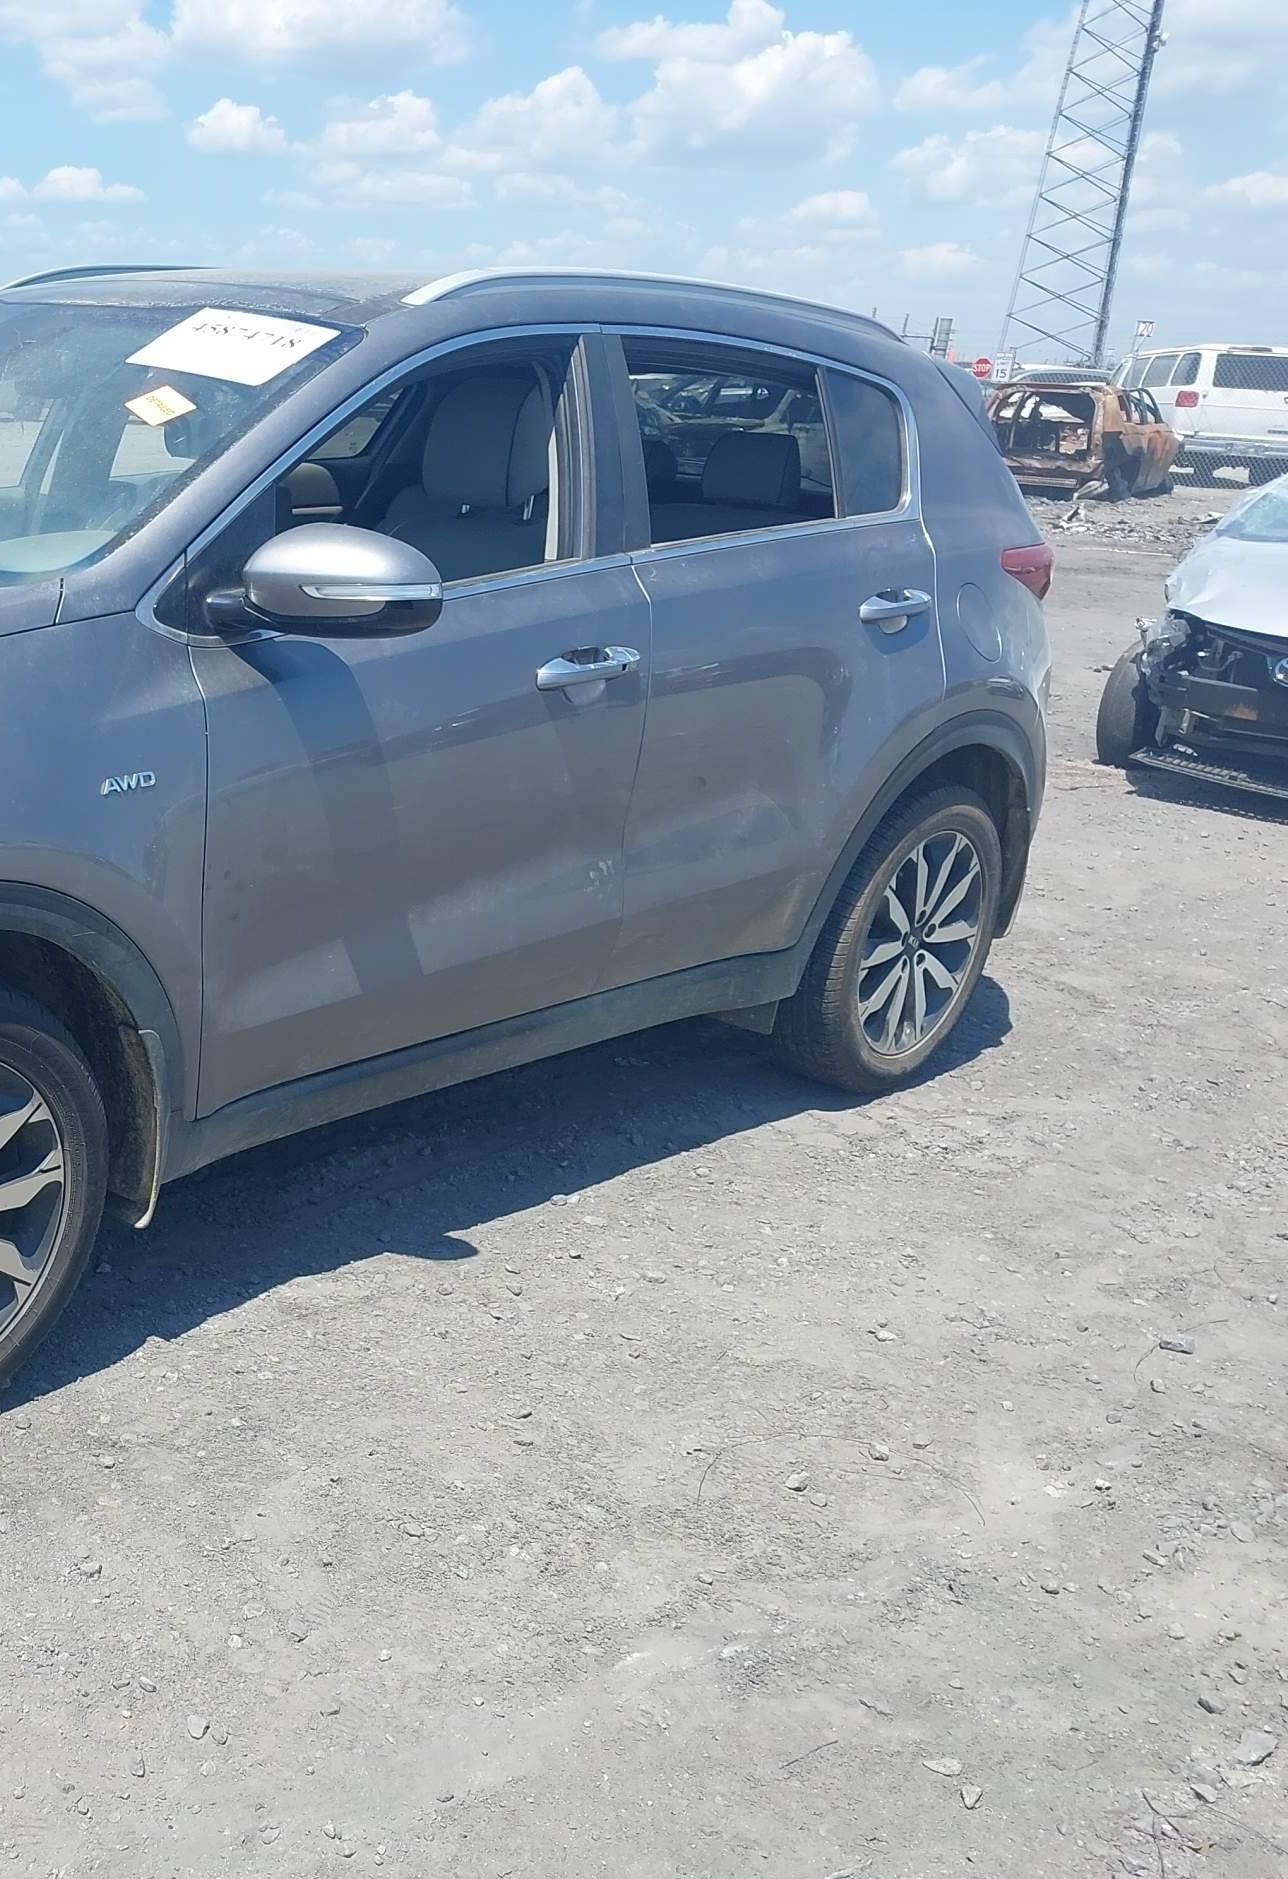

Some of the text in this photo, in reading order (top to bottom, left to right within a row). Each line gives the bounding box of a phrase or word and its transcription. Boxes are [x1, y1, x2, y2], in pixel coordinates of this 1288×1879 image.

[973, 363, 991, 373] STOP
[995, 368, 1008, 379] 15
[100, 770, 156, 795] AWD
